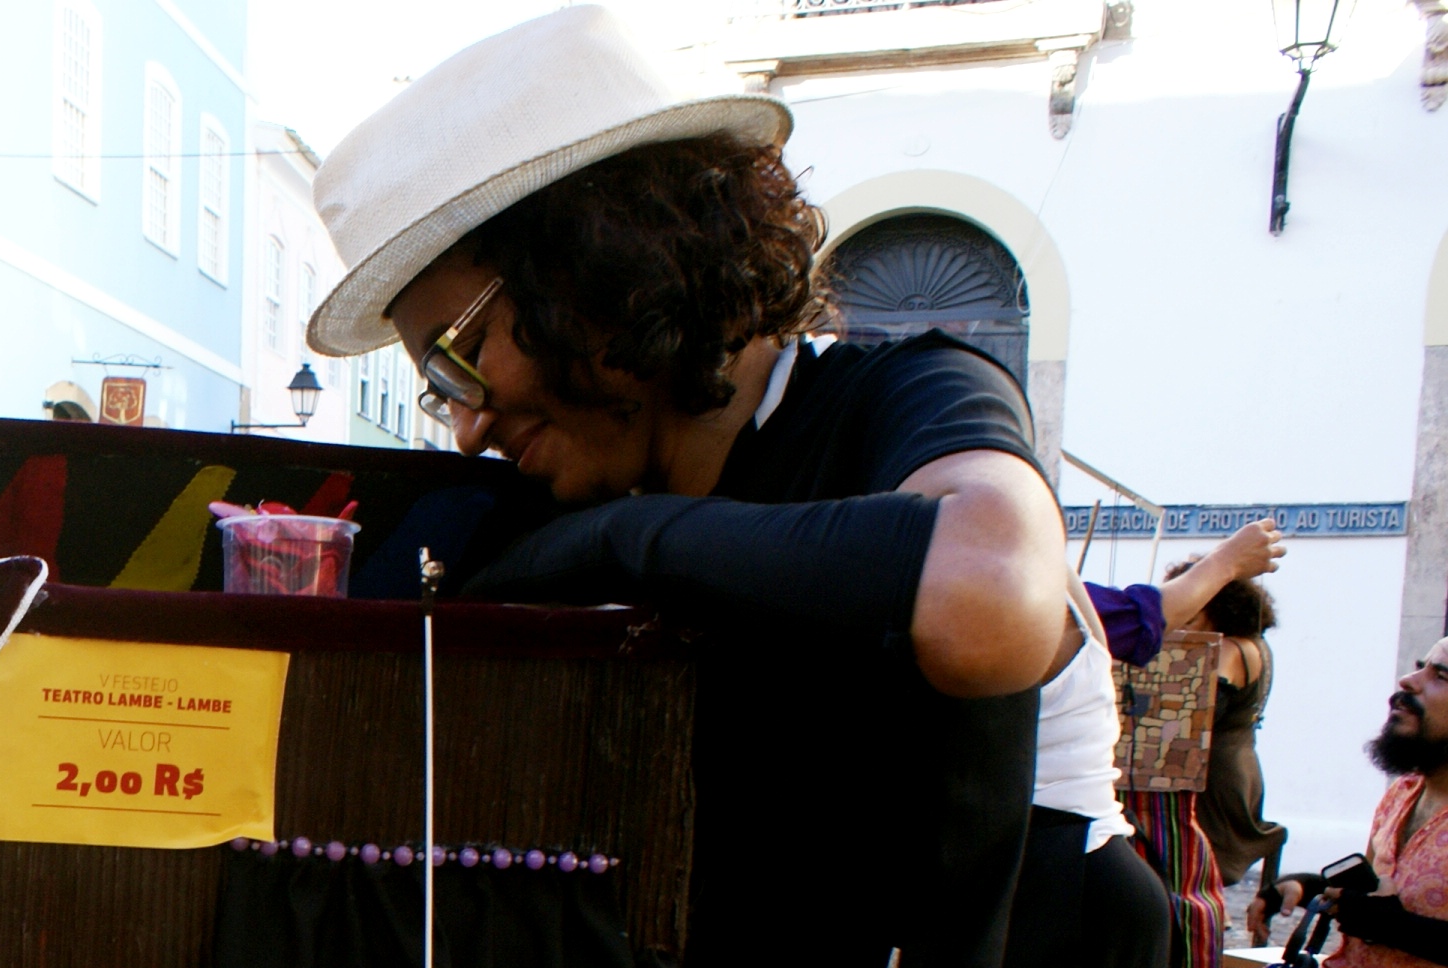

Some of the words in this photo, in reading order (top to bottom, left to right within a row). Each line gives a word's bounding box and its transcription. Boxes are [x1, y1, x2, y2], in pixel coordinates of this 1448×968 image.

[1167, 511, 1191, 530] DE
[1296, 509, 1320, 529] AO
[1326, 508, 1400, 528] TURISTA
[99, 674, 110, 688] V
[112, 674, 179, 693] FESTEJO
[42, 688, 104, 705] TEATRO
[107, 692, 164, 709] LAMBE
[177, 697, 233, 714] LAMBE
[98, 729, 172, 753] VALOR
[56, 762, 143, 798] 2,00
[153, 763, 205, 800] R$
